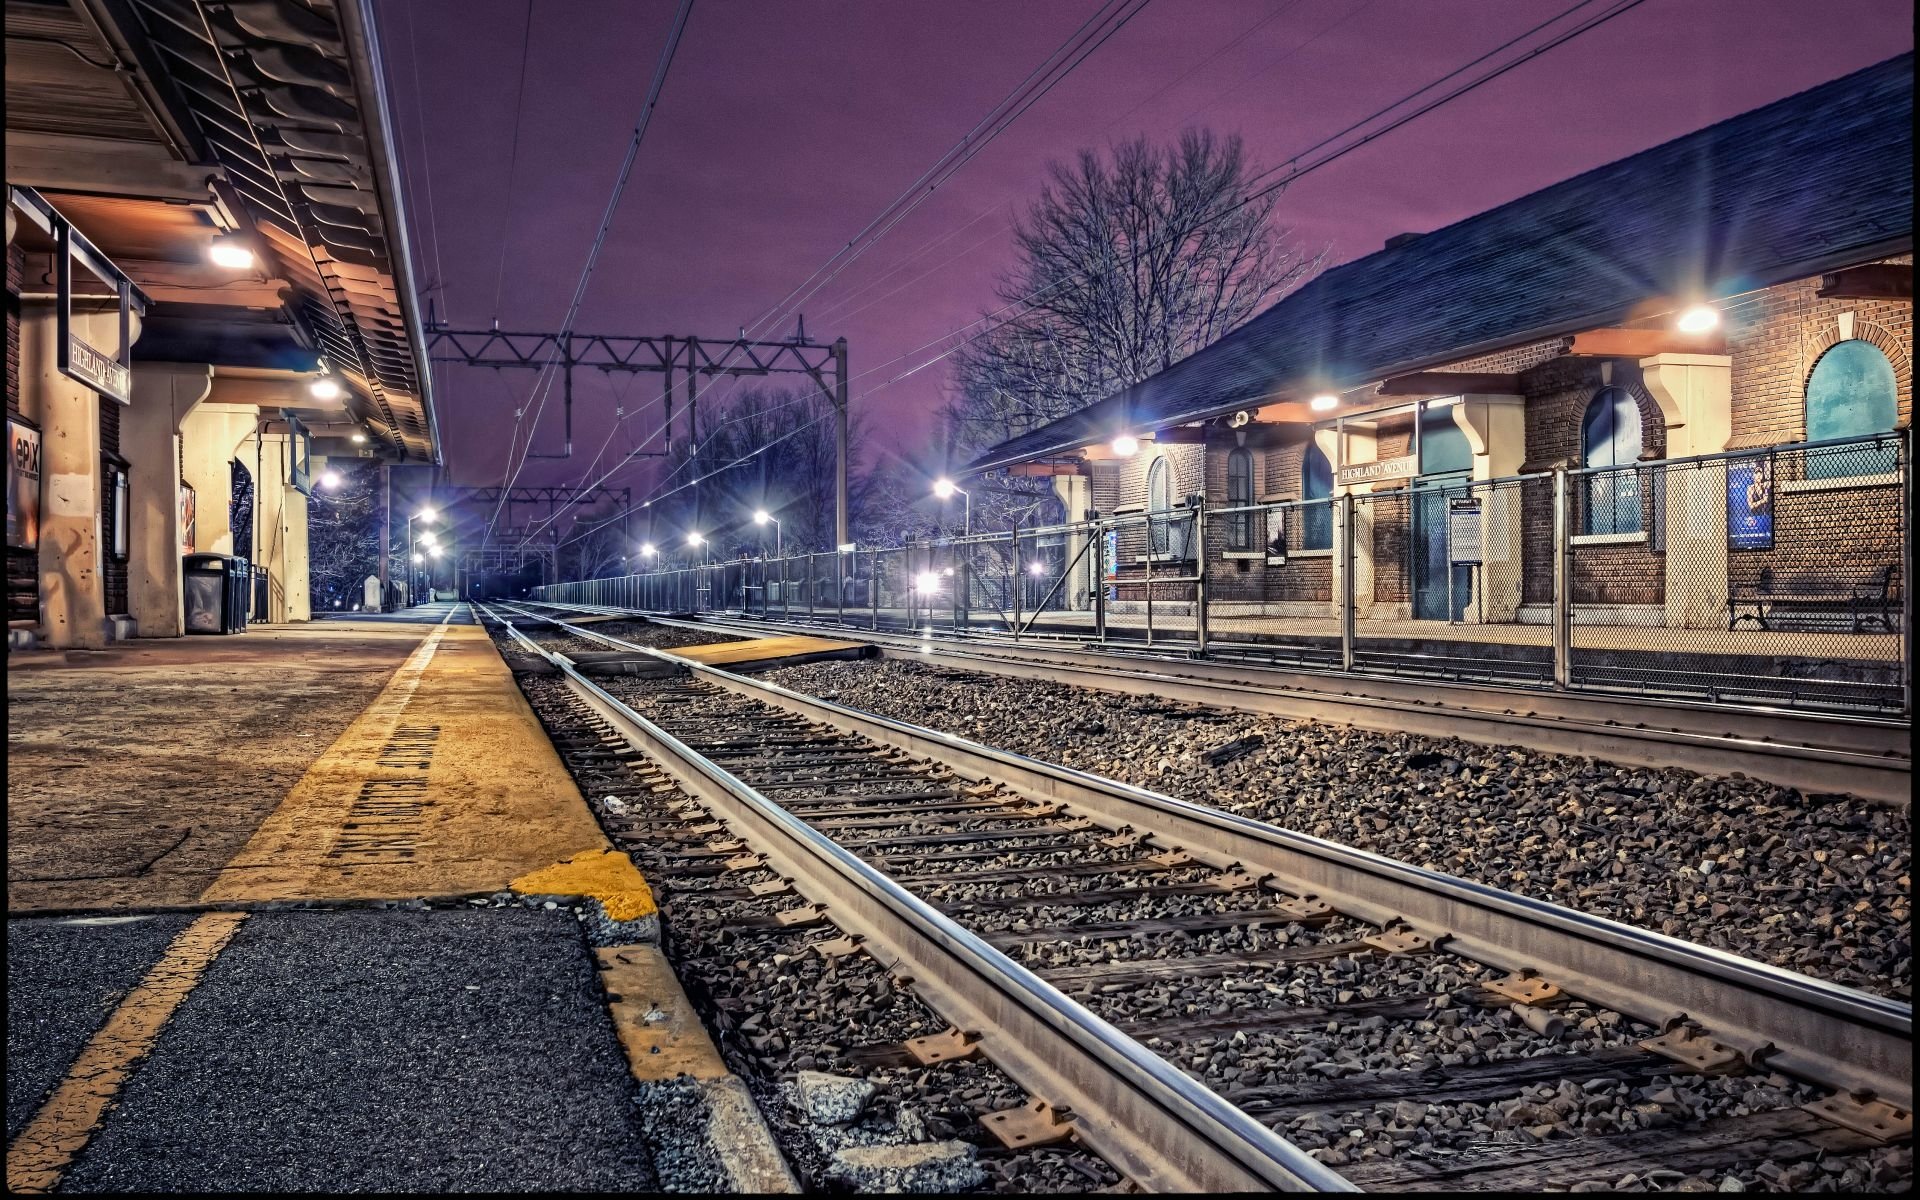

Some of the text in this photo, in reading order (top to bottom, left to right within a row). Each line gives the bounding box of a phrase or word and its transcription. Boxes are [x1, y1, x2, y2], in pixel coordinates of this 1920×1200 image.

[72, 343, 105, 379] HIGHLAND
[1341, 460, 1414, 480] HIGHLAND AVENUE
